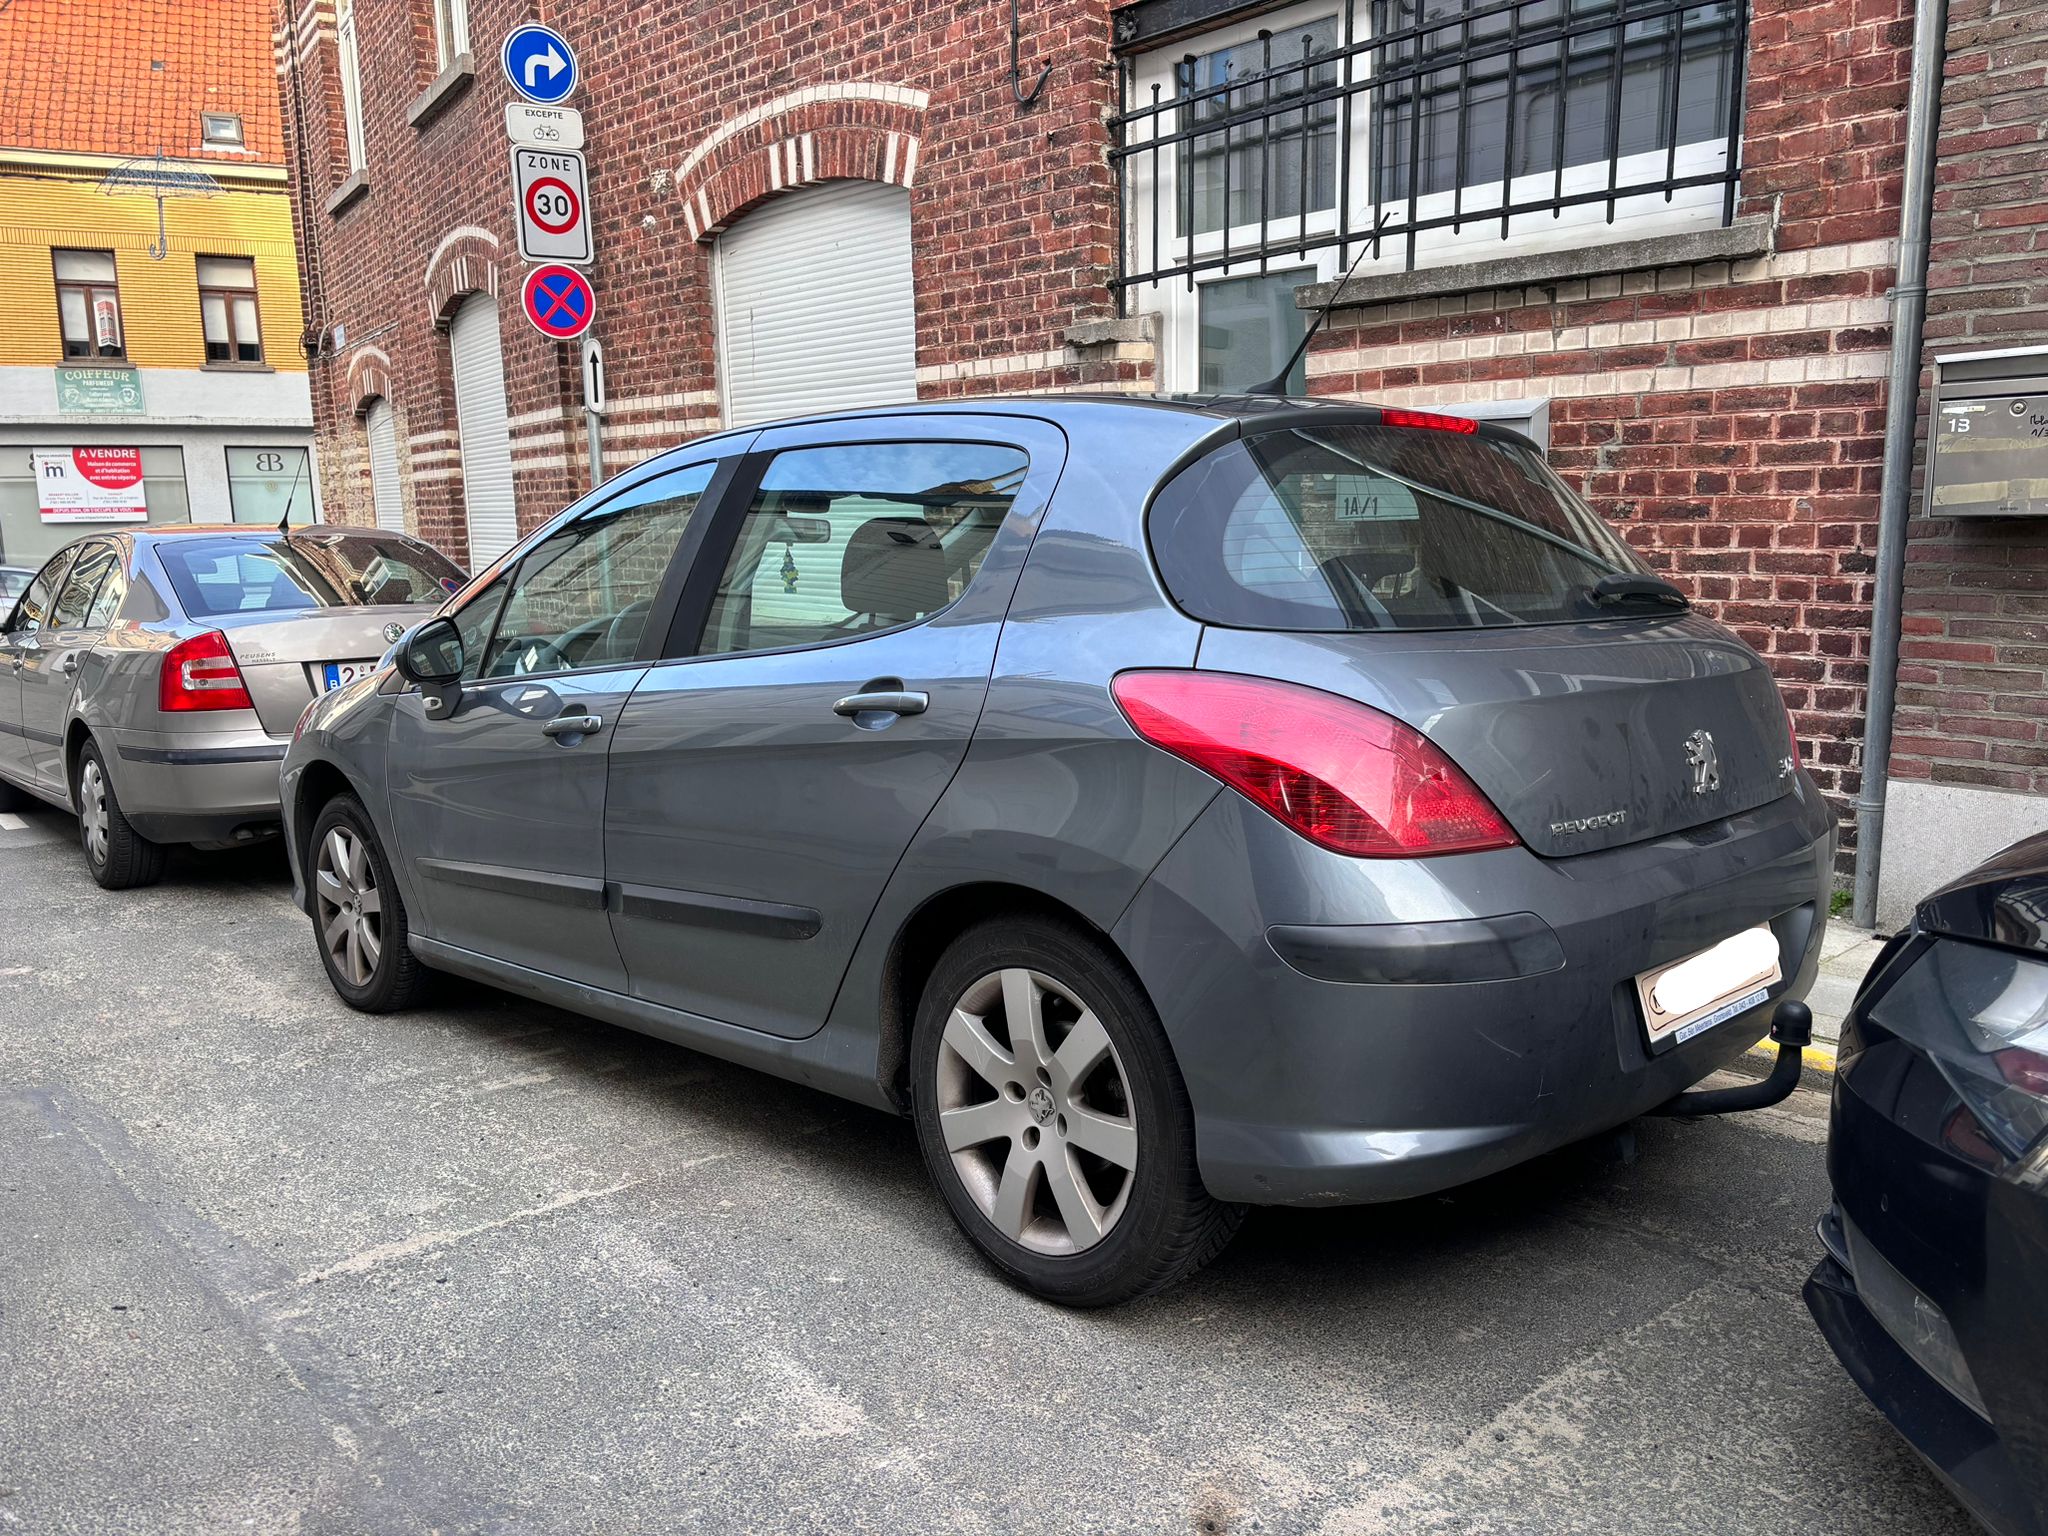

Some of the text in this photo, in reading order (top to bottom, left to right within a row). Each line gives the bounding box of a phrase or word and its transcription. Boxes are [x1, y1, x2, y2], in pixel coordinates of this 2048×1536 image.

[525, 109, 564, 120] EXCEPTE
[528, 156, 571, 172] ZONE
[537, 193, 569, 217] 30
[64, 370, 130, 382] COIFFEUR
[1948, 418, 1970, 433] 13
[89, 449, 137, 459] VENDRE
[1343, 496, 1378, 516] 1A/1
[330, 680, 338, 689] B
[1550, 810, 1627, 837] PEUGEOT
